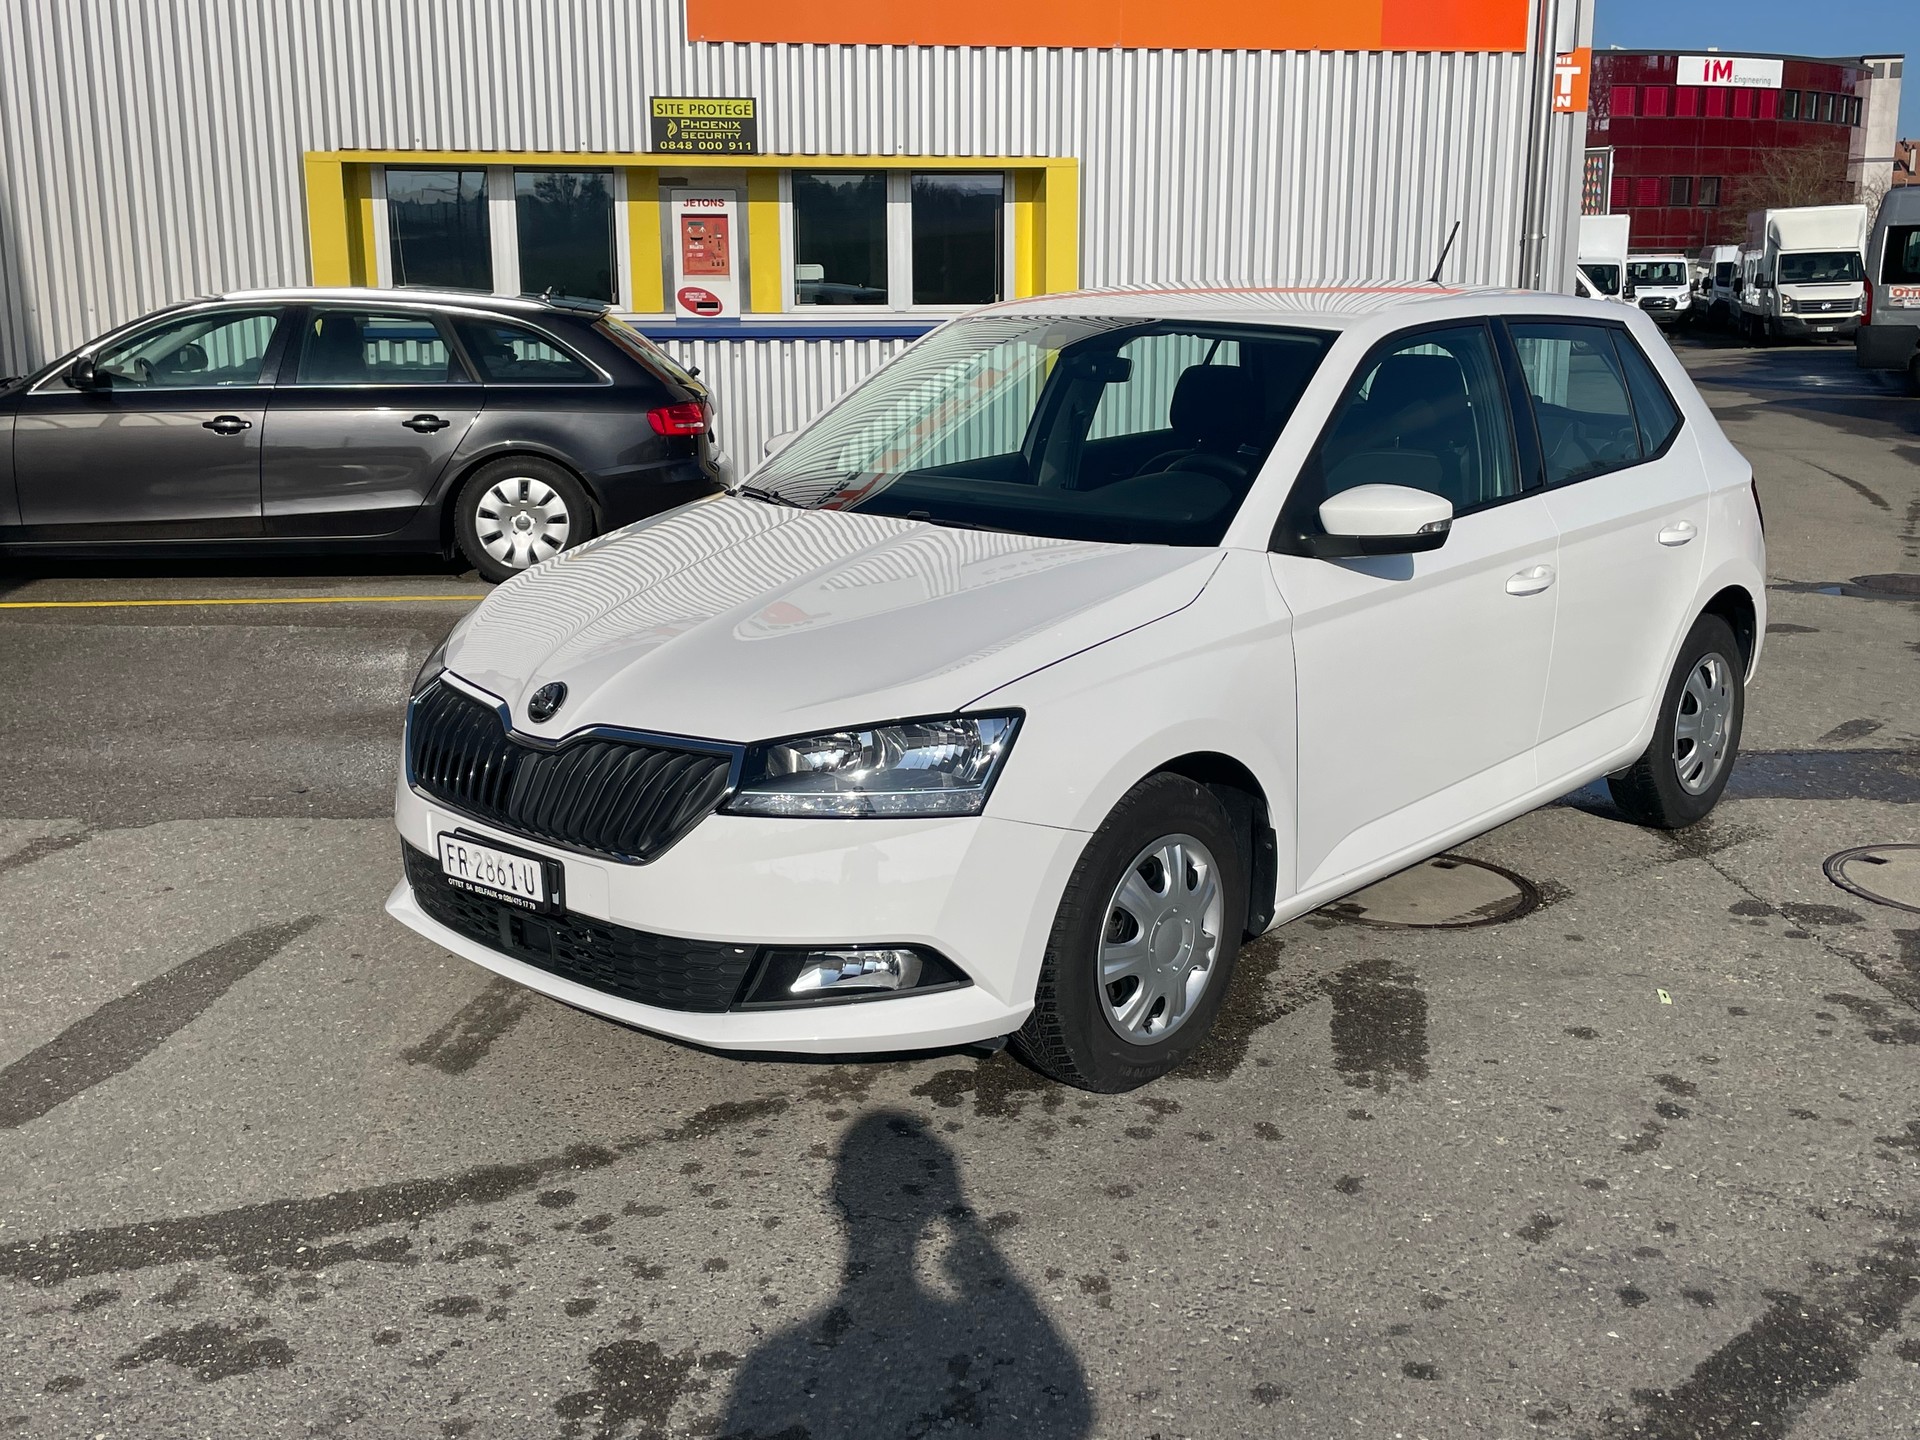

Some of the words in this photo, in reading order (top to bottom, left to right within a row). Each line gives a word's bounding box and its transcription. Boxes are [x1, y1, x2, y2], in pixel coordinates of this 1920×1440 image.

[1734, 74, 1772, 87] Engineering
[656, 103, 684, 115] SITE
[689, 101, 752, 116] PROTÉGÉ
[680, 119, 742, 129] PHOENIX
[681, 131, 742, 140] SECURITY
[659, 141, 693, 150] 0848
[698, 141, 723, 150] 000
[728, 141, 752, 150] 911
[683, 198, 726, 208] JETONS
[447, 877, 464, 889] OTTET
[465, 882, 474, 892] SA
